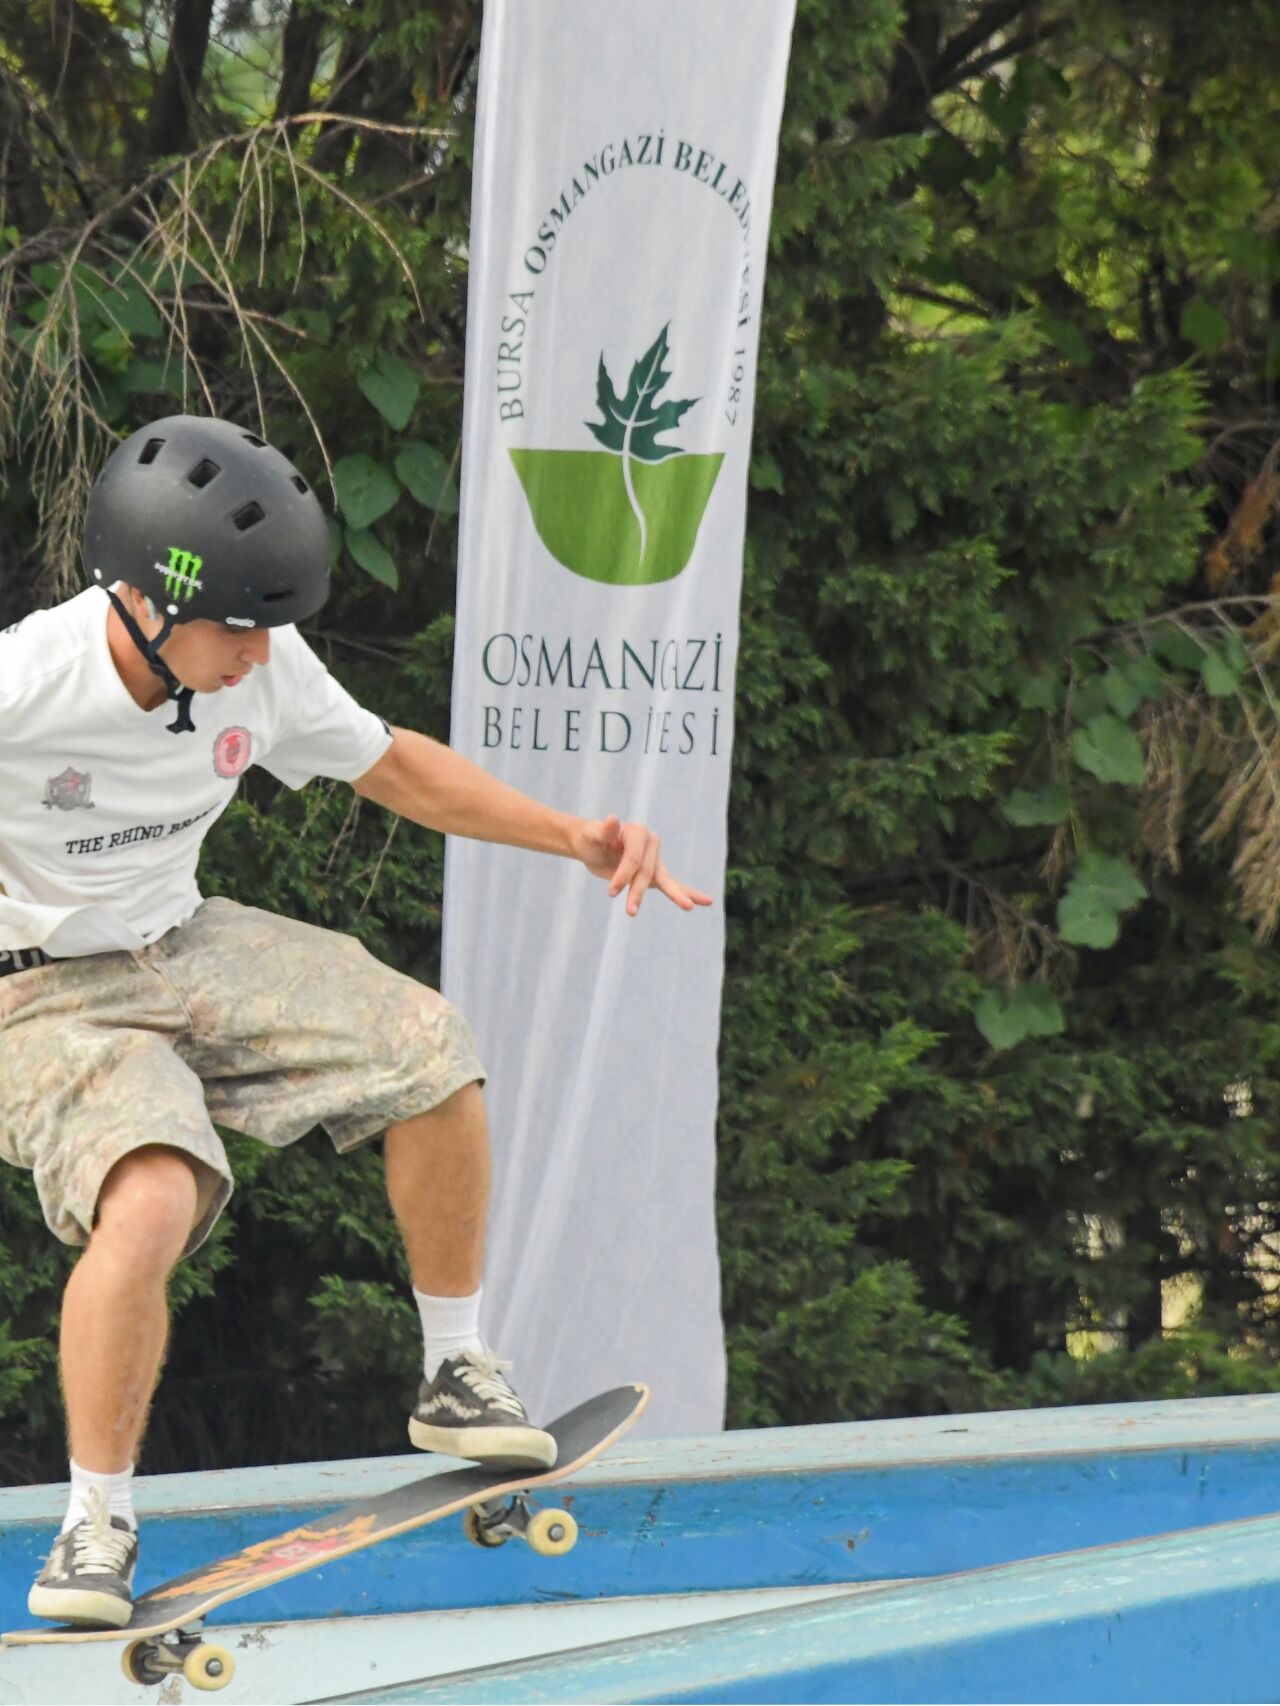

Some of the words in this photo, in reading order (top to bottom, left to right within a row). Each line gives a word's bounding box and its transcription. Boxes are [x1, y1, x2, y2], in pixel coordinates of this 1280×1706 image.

[497, 289, 536, 424] BURSA
[524, 128, 666, 275] OSMANGAZİ
[725, 348, 746, 427] 1987
[482, 706, 720, 756] BELEDİESİ
[65, 835, 104, 855] THE
[108, 824, 164, 848] RHINO
